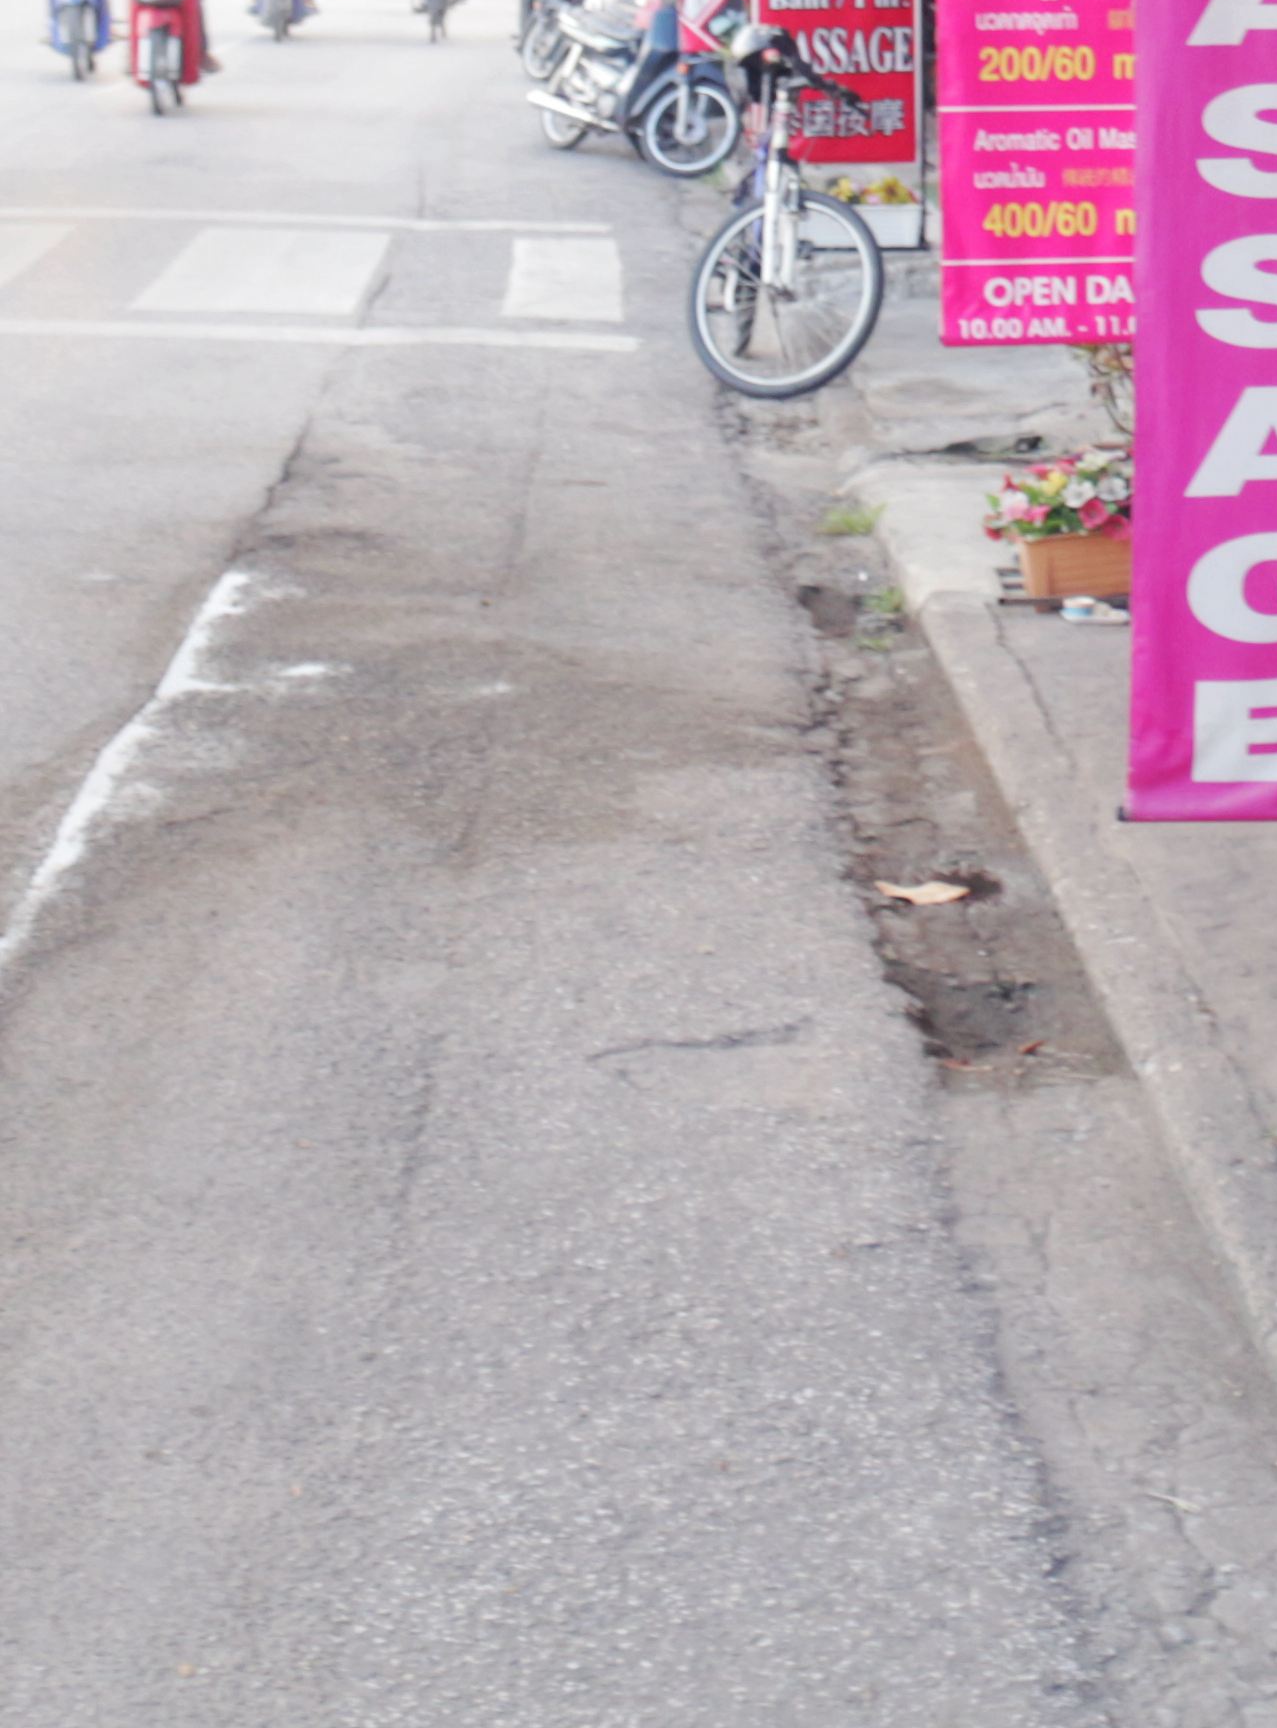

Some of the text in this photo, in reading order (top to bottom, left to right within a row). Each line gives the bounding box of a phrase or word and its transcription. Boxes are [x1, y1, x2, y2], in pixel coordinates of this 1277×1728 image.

[978, 45, 1097, 82] 200/60
[973, 129, 1061, 152] Aromatic
[1066, 127, 1093, 150] Oil
[982, 201, 1097, 238] 400/60
[984, 276, 1076, 307] OPEN
[959, 319, 1023, 340] 10.00
